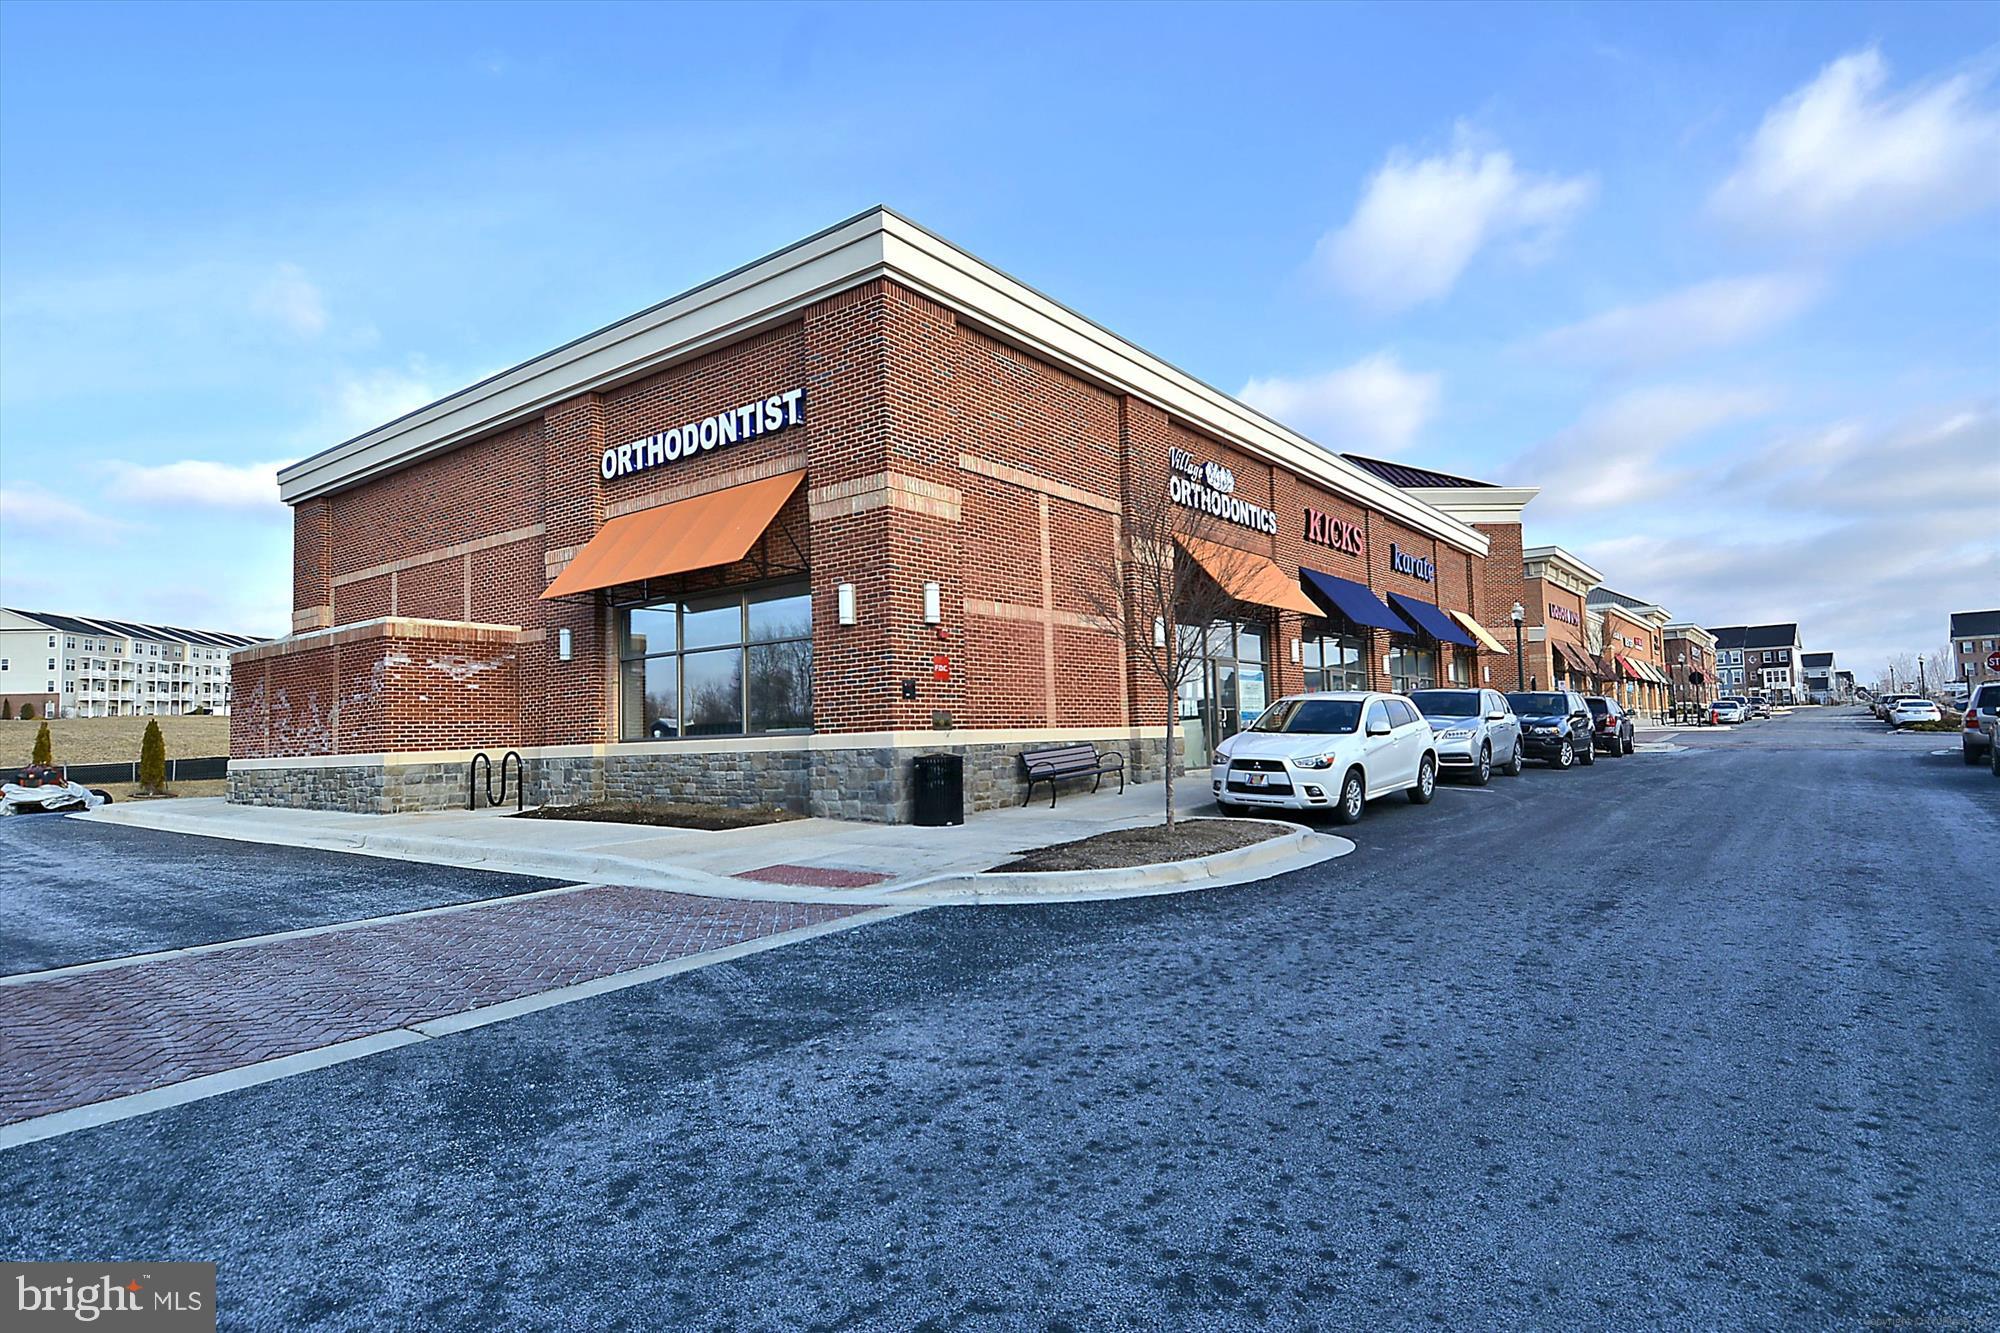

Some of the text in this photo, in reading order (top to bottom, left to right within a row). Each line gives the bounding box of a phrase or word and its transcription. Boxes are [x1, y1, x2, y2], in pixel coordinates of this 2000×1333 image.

[600, 387, 805, 480] ORTHODONTIST
[1168, 445, 1203, 481] Village
[1169, 474, 1277, 535] ORTHODONTICS
[1308, 507, 1364, 556] KICKS
[1393, 543, 1436, 583] karate
[934, 664, 949, 672] FDC
